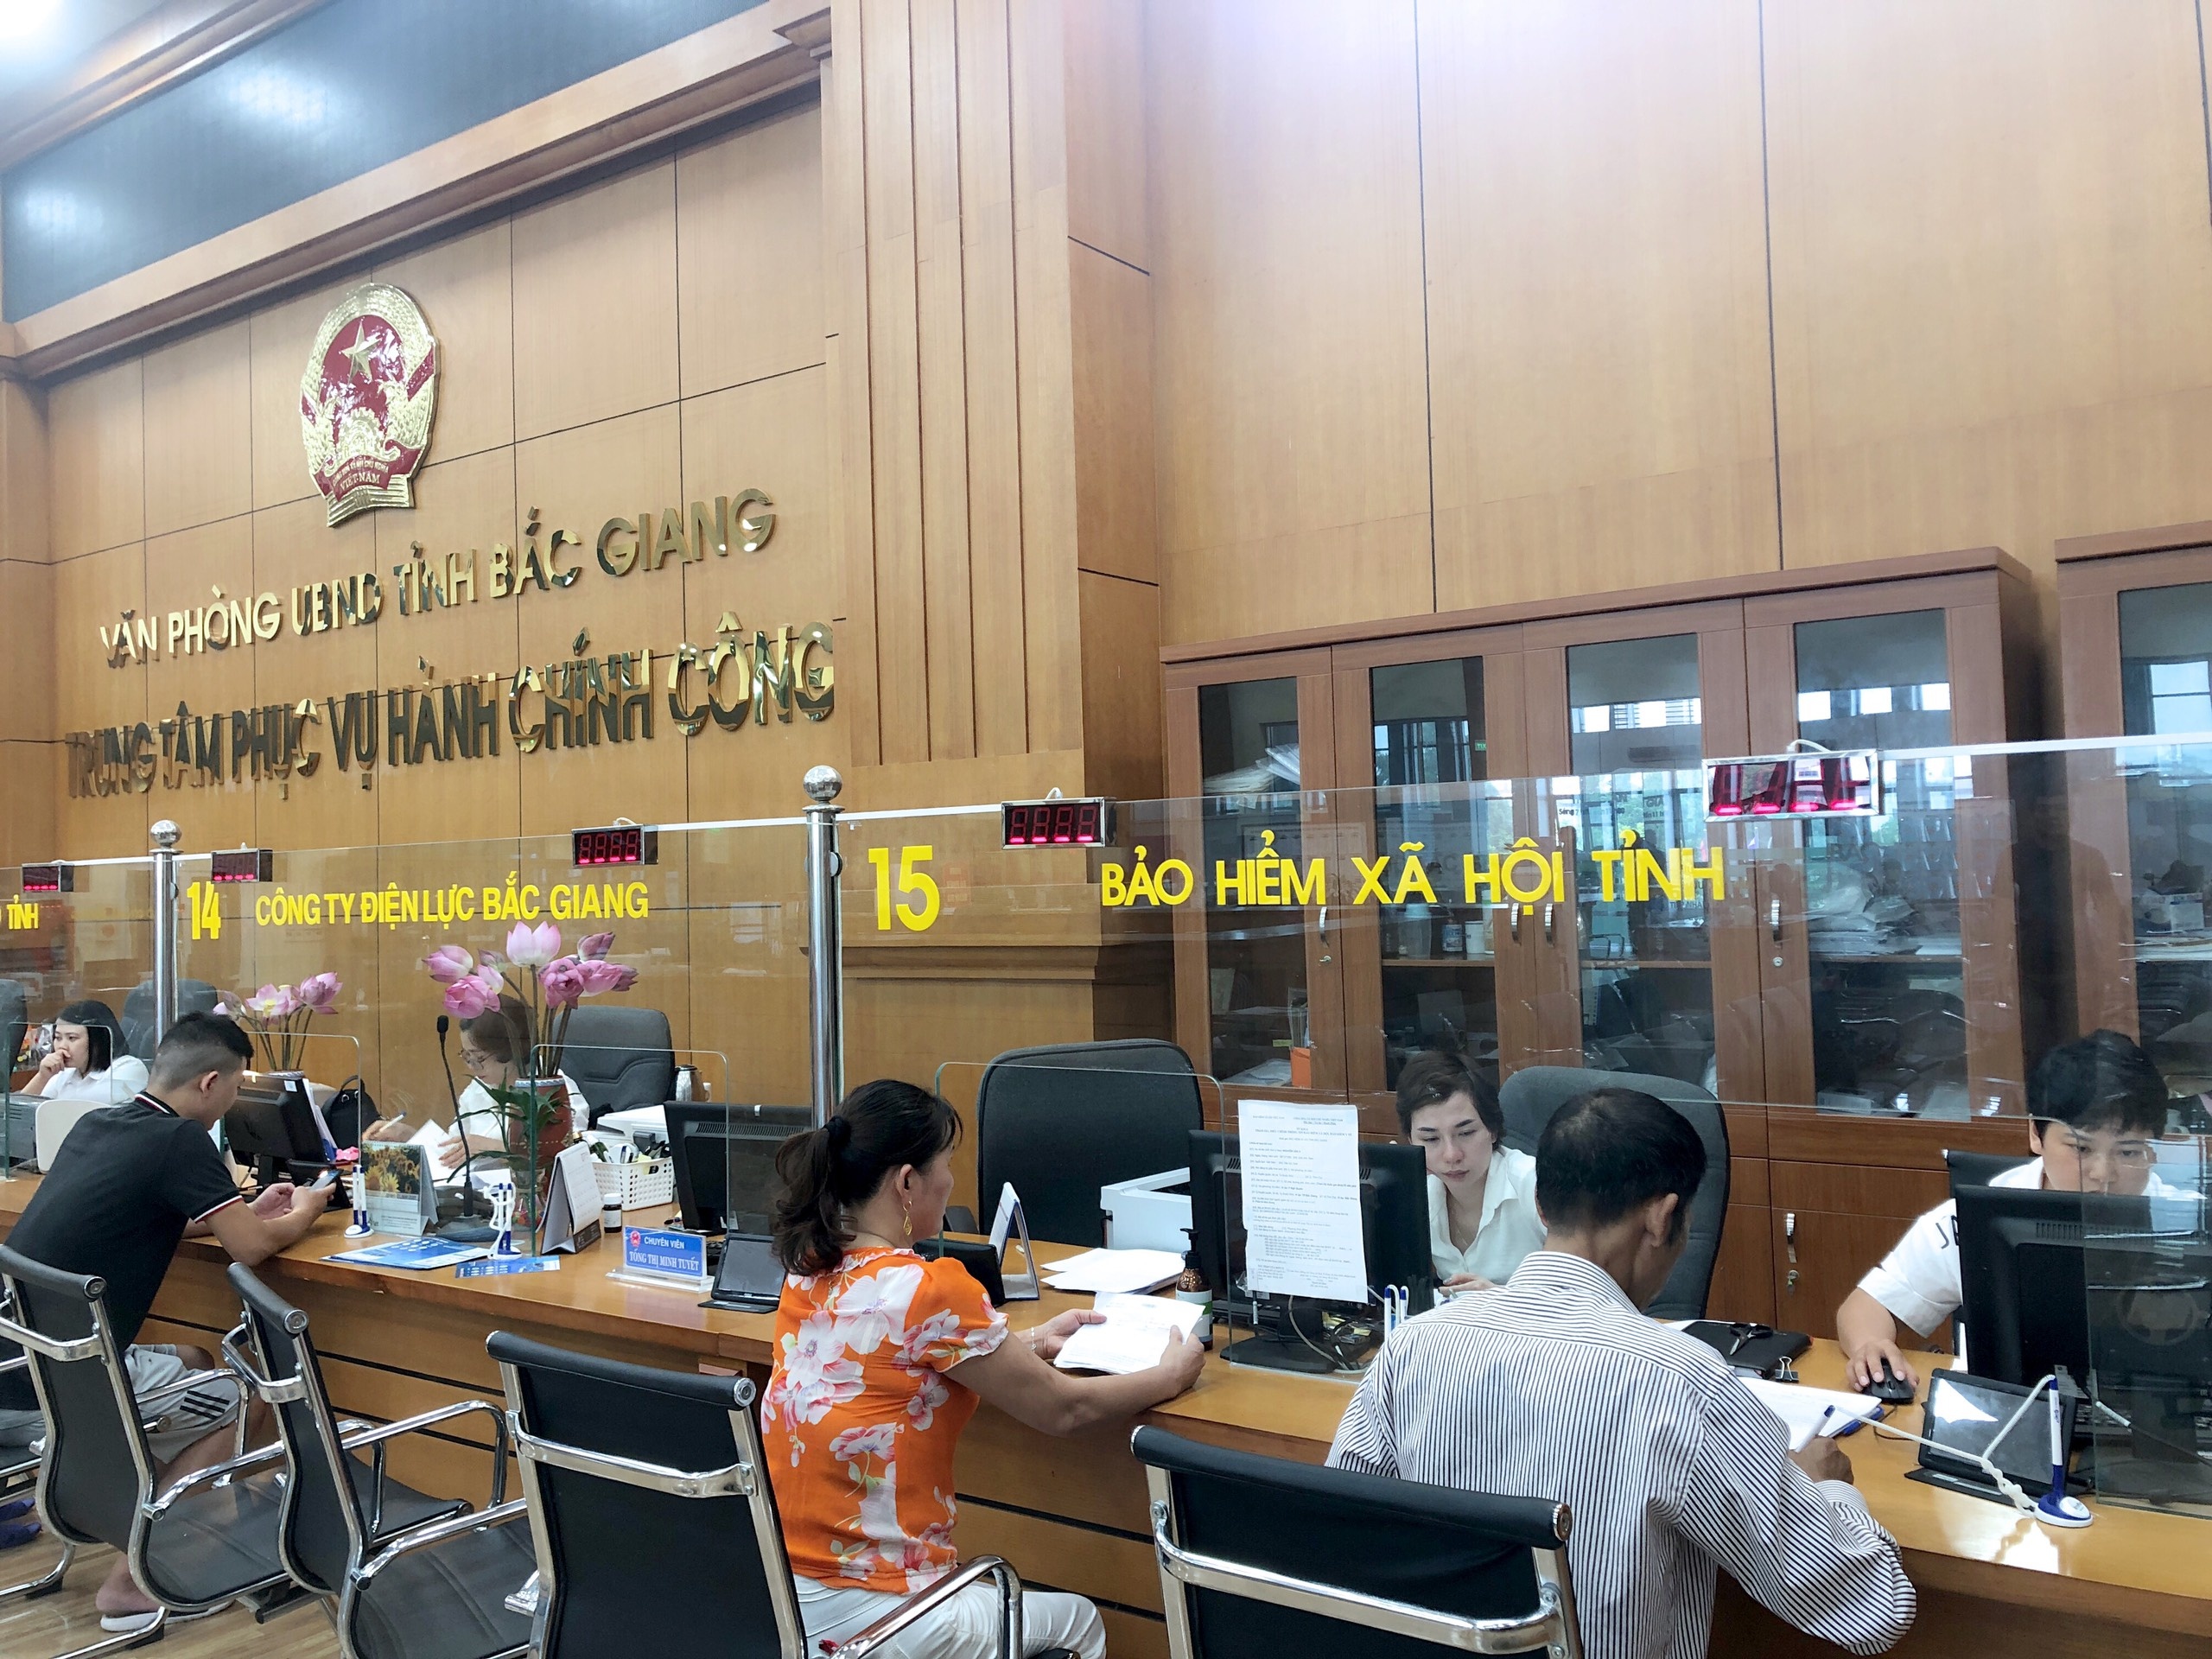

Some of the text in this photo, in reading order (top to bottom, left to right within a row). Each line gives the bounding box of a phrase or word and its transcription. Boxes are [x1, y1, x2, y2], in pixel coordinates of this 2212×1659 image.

[99, 487, 777, 669] VĂN PHÒNG UBND TỈNH BẮC GIANG
[65, 611, 835, 801] TRUNG TÂM PHỤC VỤ HÀNH CHÍNH CÔNG
[256, 871, 649, 931] CÔNG TY ĐIỆN LỰC BẮC GIANG
[868, 845, 940, 931] 15
[1101, 829, 1726, 915] BẢO HIỂM XÃ HỘI TỈNH
[6, 893, 39, 930] TỈNH
[187, 880, 221, 940] 14
[644, 1236, 685, 1249] CHUYÊN VIÊN
